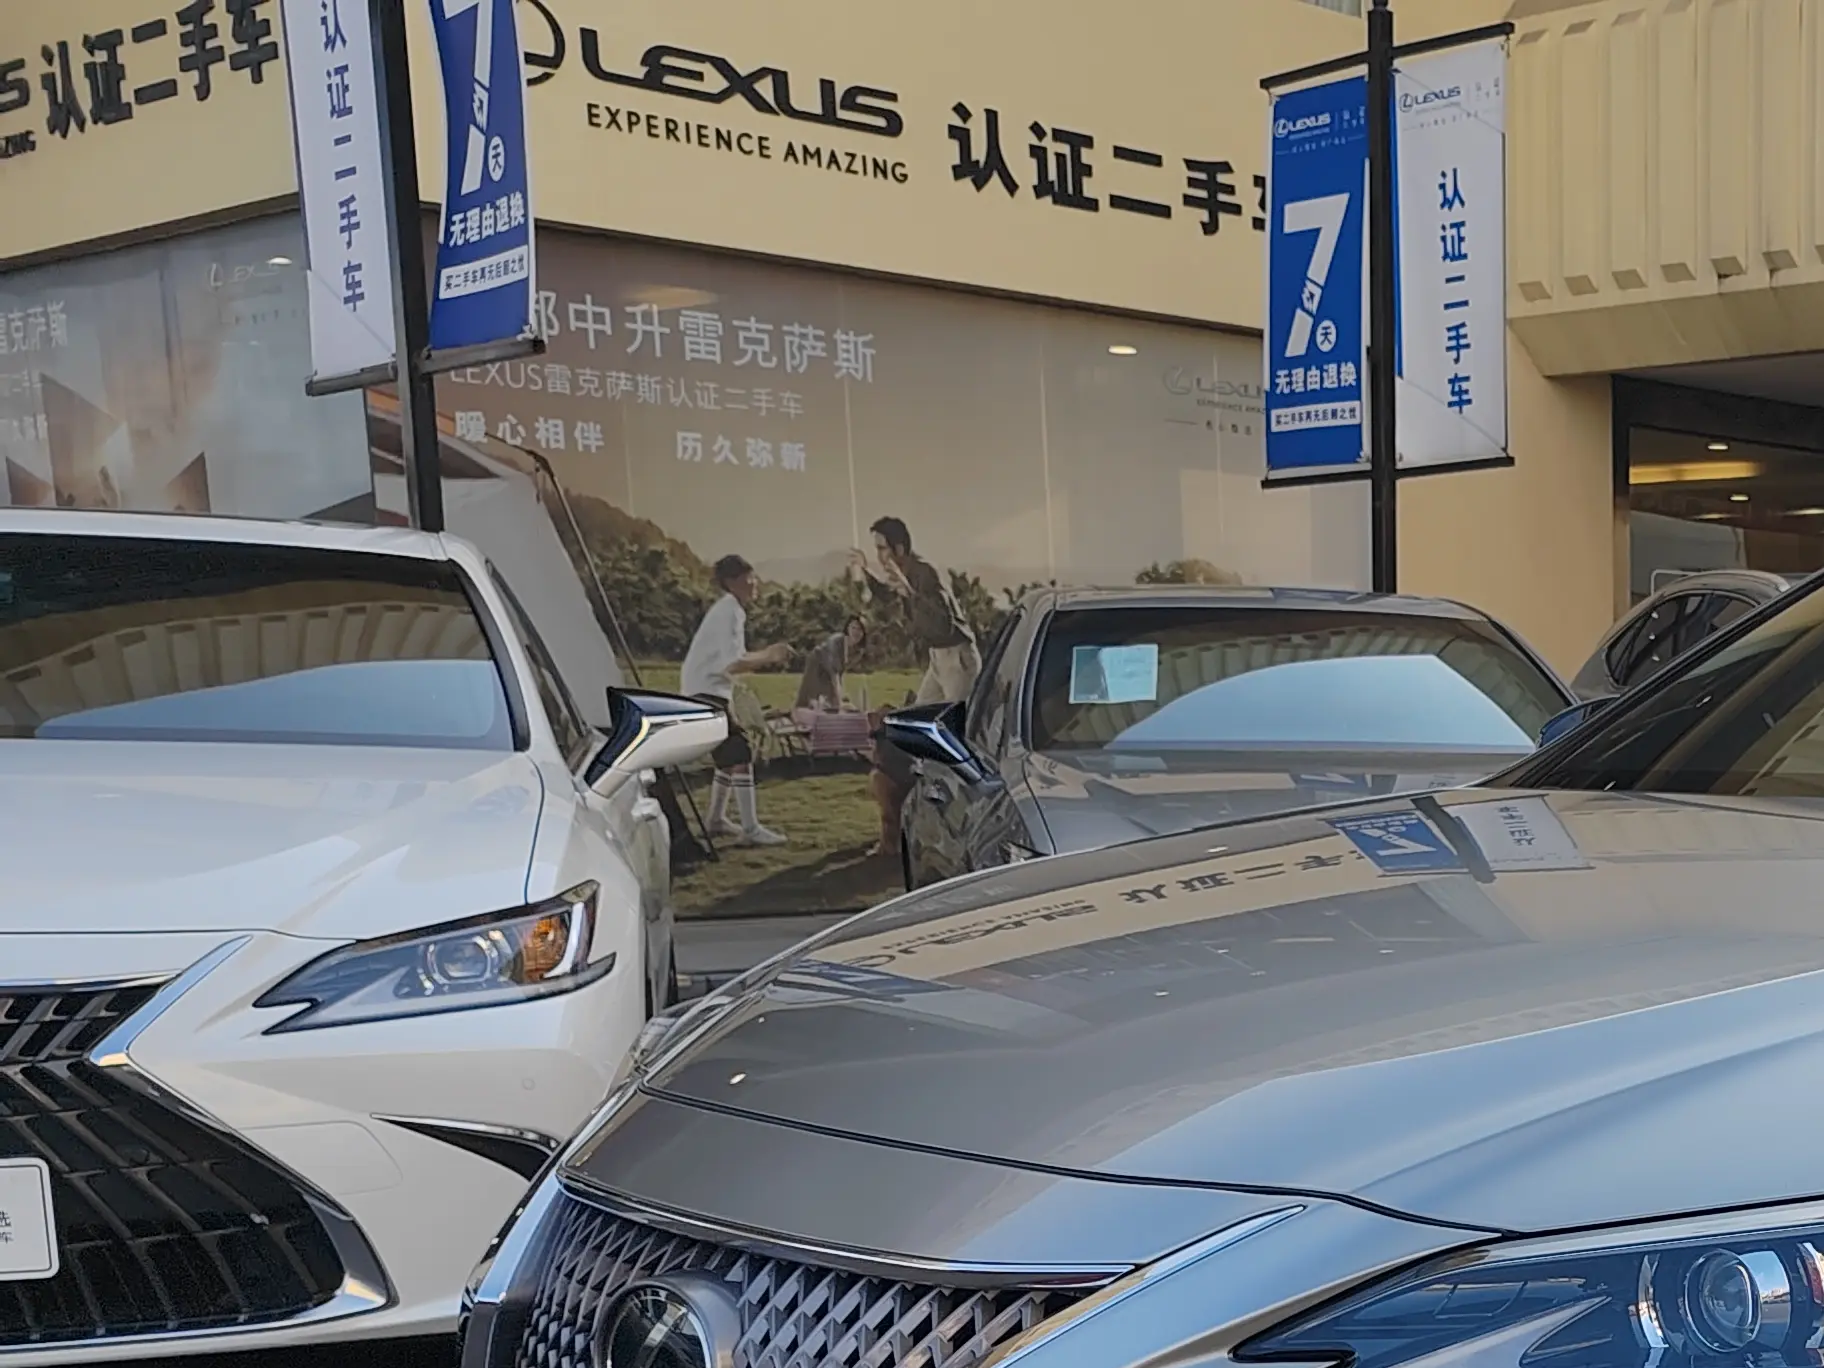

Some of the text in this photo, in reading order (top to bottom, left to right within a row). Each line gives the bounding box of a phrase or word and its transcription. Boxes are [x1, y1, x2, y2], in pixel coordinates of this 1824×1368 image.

[40, 0, 280, 139] 认证二手车
[579, 27, 904, 138] LEXUS
[1414, 86, 1462, 106] LEXUS
[320, 0, 365, 313] 认证二手车
[586, 102, 910, 185] EXPERIENCE AMAZING
[948, 101, 1266, 236] 认证二手
[1289, 112, 1332, 132] LEXUS
[450, 190, 526, 249] 无理由退换
[1283, 192, 1351, 357] 7
[1438, 167, 1473, 415] 认证二手车
[1275, 361, 1358, 395] 无理由退换
[455, 410, 807, 472] 暖心相伴 历久弥新
